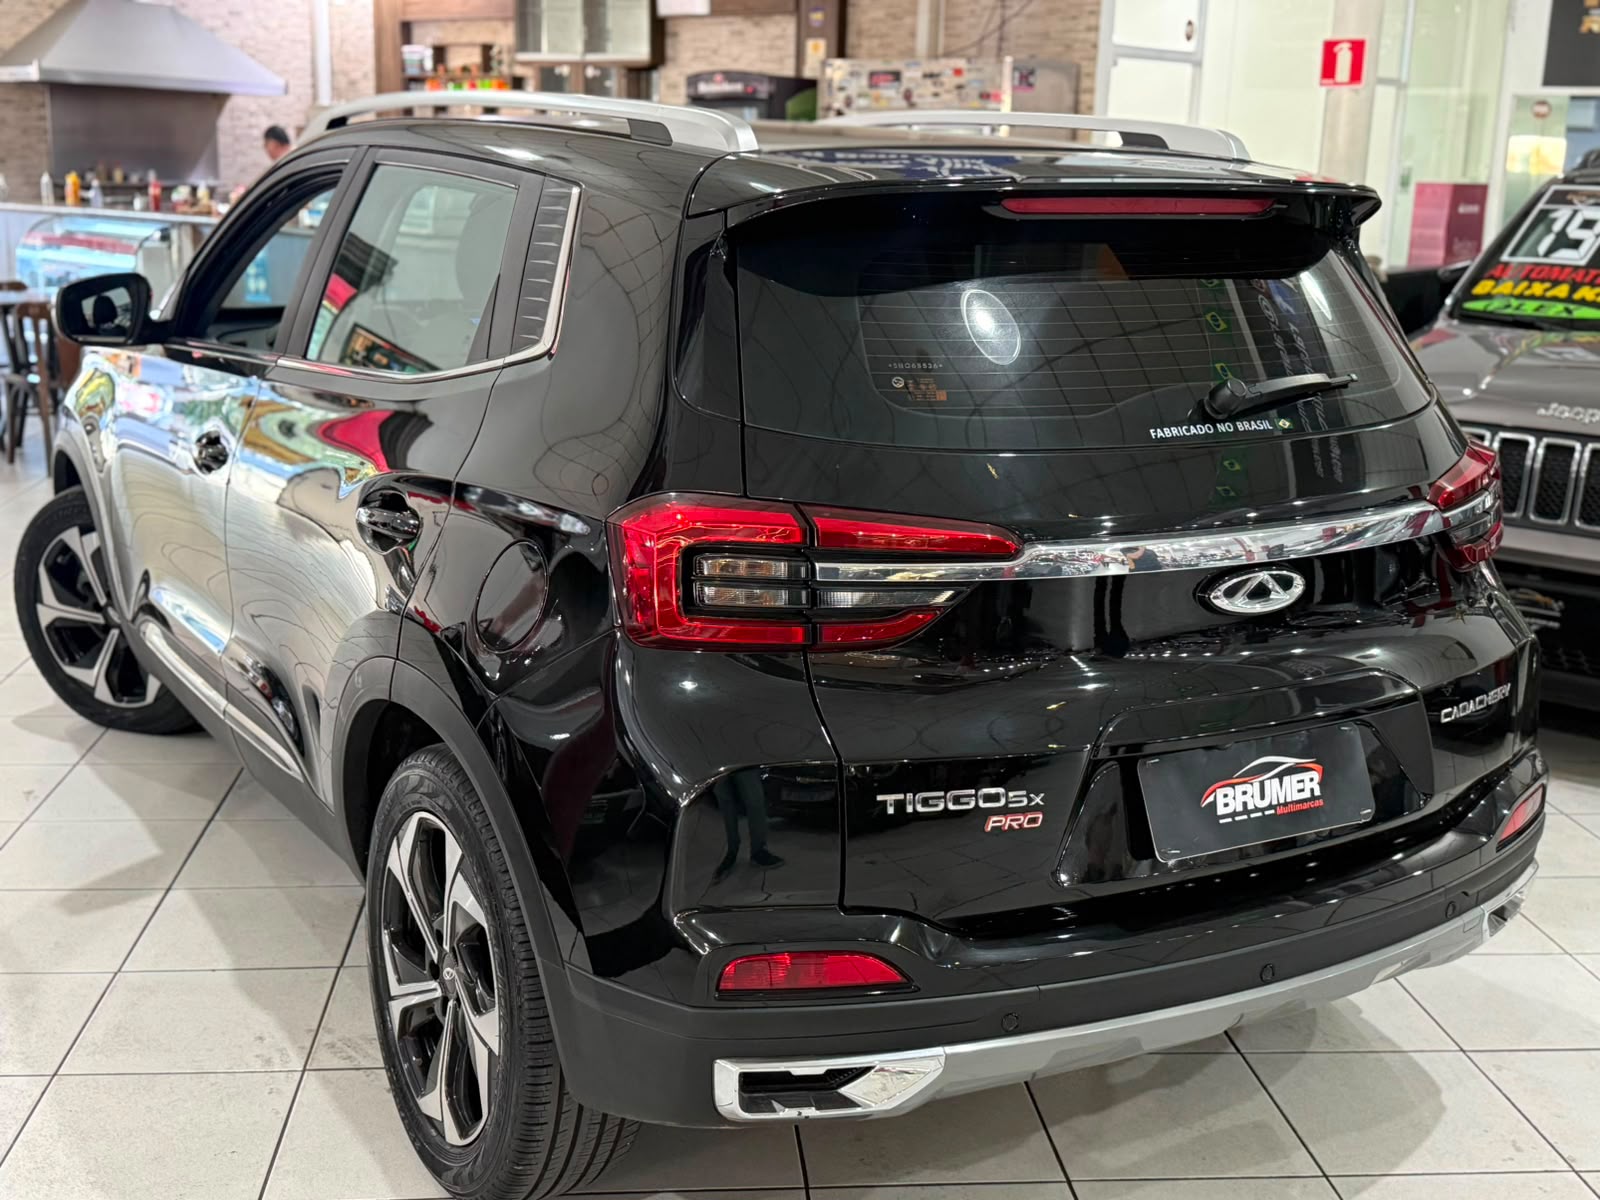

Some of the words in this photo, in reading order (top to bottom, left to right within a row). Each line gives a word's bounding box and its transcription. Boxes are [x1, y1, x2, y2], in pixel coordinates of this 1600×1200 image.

[1537, 208, 1600, 260] 19
[1471, 279, 1570, 300] BAIXA
[1149, 424, 1214, 439] FABRICADO
[1216, 422, 1234, 433] NO
[1236, 419, 1273, 431] BRASIL
[1214, 770, 1322, 816] BRUMER
[1276, 798, 1324, 816] Multimarcas
[984, 811, 1044, 832] PRO
